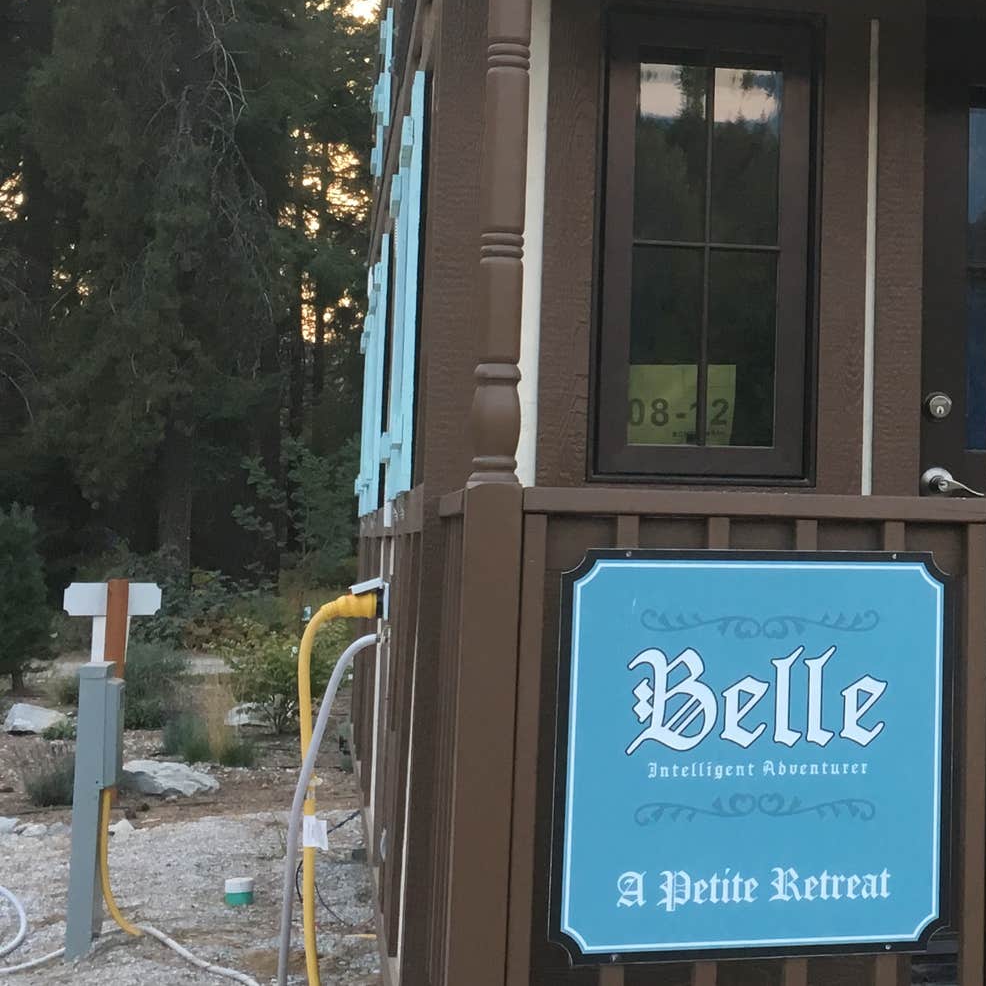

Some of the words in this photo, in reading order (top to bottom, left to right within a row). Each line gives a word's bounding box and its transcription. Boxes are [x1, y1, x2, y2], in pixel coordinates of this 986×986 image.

[624, 644, 889, 756] Belle
[647, 761, 755, 780] Intelligent
[762, 759, 868, 777] Adventurer
[616, 869, 647, 908] A
[656, 867, 759, 912] Petite
[768, 866, 891, 902] Retreat
